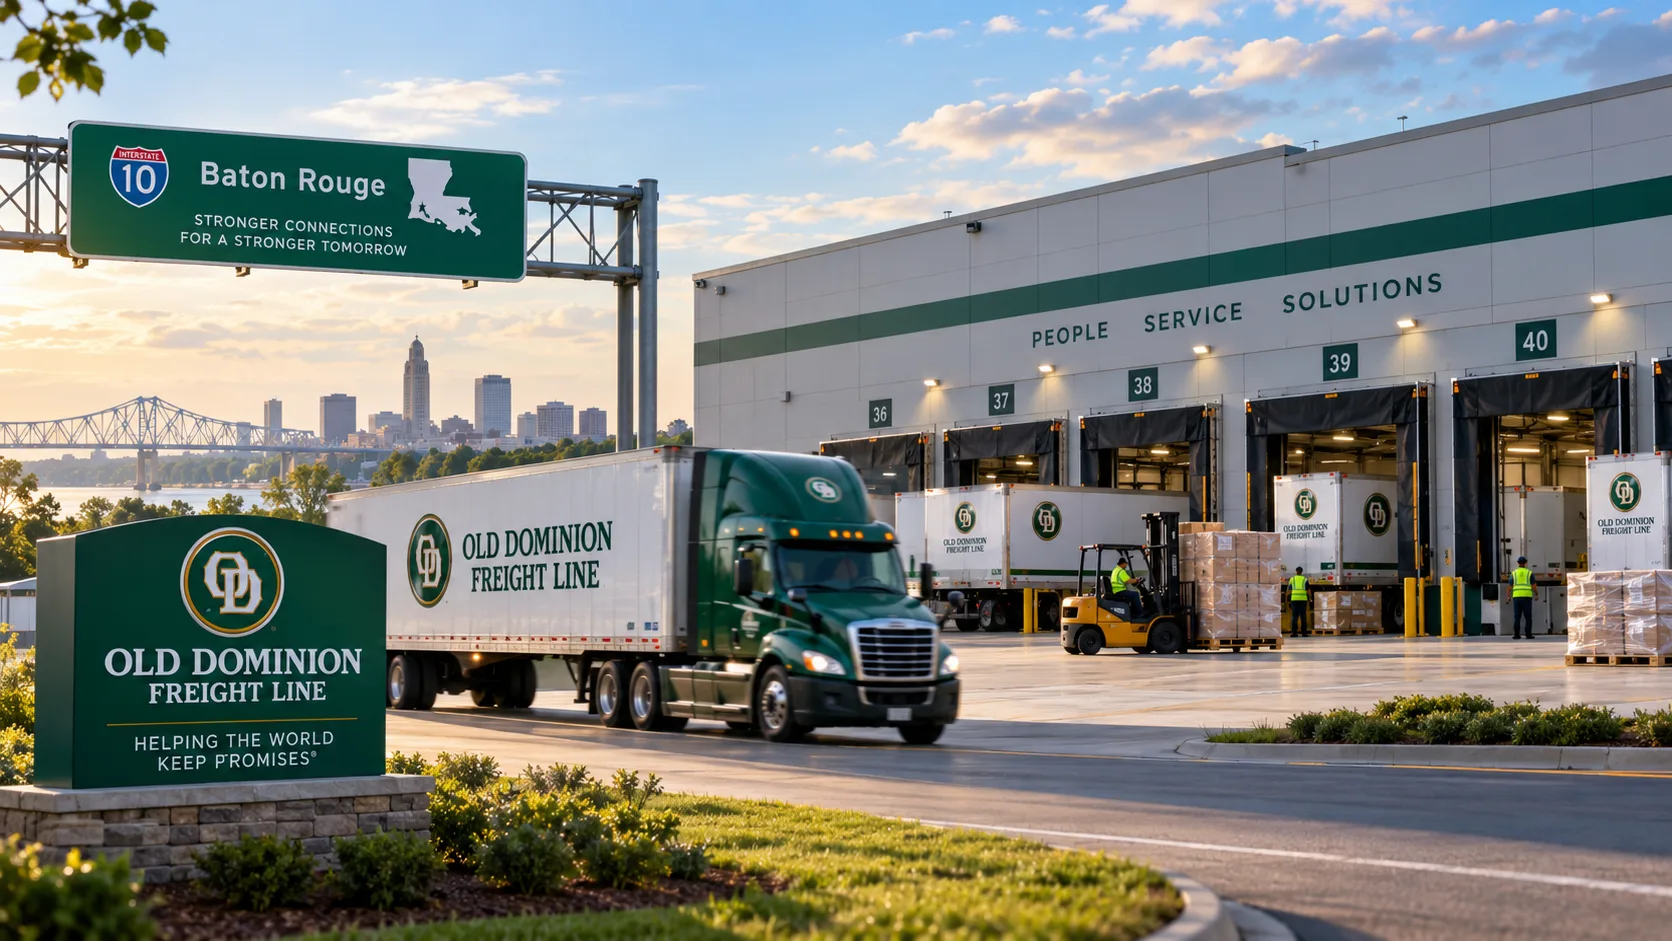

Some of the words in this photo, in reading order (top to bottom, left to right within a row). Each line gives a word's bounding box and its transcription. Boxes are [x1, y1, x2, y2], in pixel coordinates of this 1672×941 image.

[118, 150, 160, 161] INTERSTATE
[122, 163, 157, 195] 10
[201, 161, 286, 190] Baton
[299, 167, 386, 201] Rouge
[194, 213, 279, 231] STRONGER
[285, 219, 393, 238] CONNECTIONS
[180, 231, 212, 245] FOR
[217, 234, 228, 246] A
[234, 234, 316, 251] STRONGER
[321, 240, 407, 257] TOMORROW
[1032, 321, 1109, 348] PEOPLE
[1144, 302, 1243, 333] SERVICE
[1282, 273, 1442, 314] SOLUTIONS
[1522, 329, 1548, 352] 40
[1329, 352, 1351, 374] 39
[1133, 376, 1152, 395] 38
[993, 392, 1009, 410] 37
[873, 406, 887, 423] 36
[1597, 518, 1614, 527] OLD
[1615, 517, 1655, 526] DOMINION
[1634, 526, 1651, 534] LINE
[462, 531, 500, 561] OLD
[504, 520, 613, 558] DOMINION
[203, 550, 263, 615] OD
[471, 563, 548, 592] FREIGHT
[553, 560, 600, 590] LINE
[104, 647, 181, 676] OLD
[191, 647, 363, 676] DOMINION
[148, 681, 263, 704] FREIGHT
[271, 681, 327, 702] LINE
[134, 734, 218, 752] HELPING
[225, 732, 261, 748] THE
[268, 731, 334, 747] WORLD
[157, 755, 207, 772] KEEP
